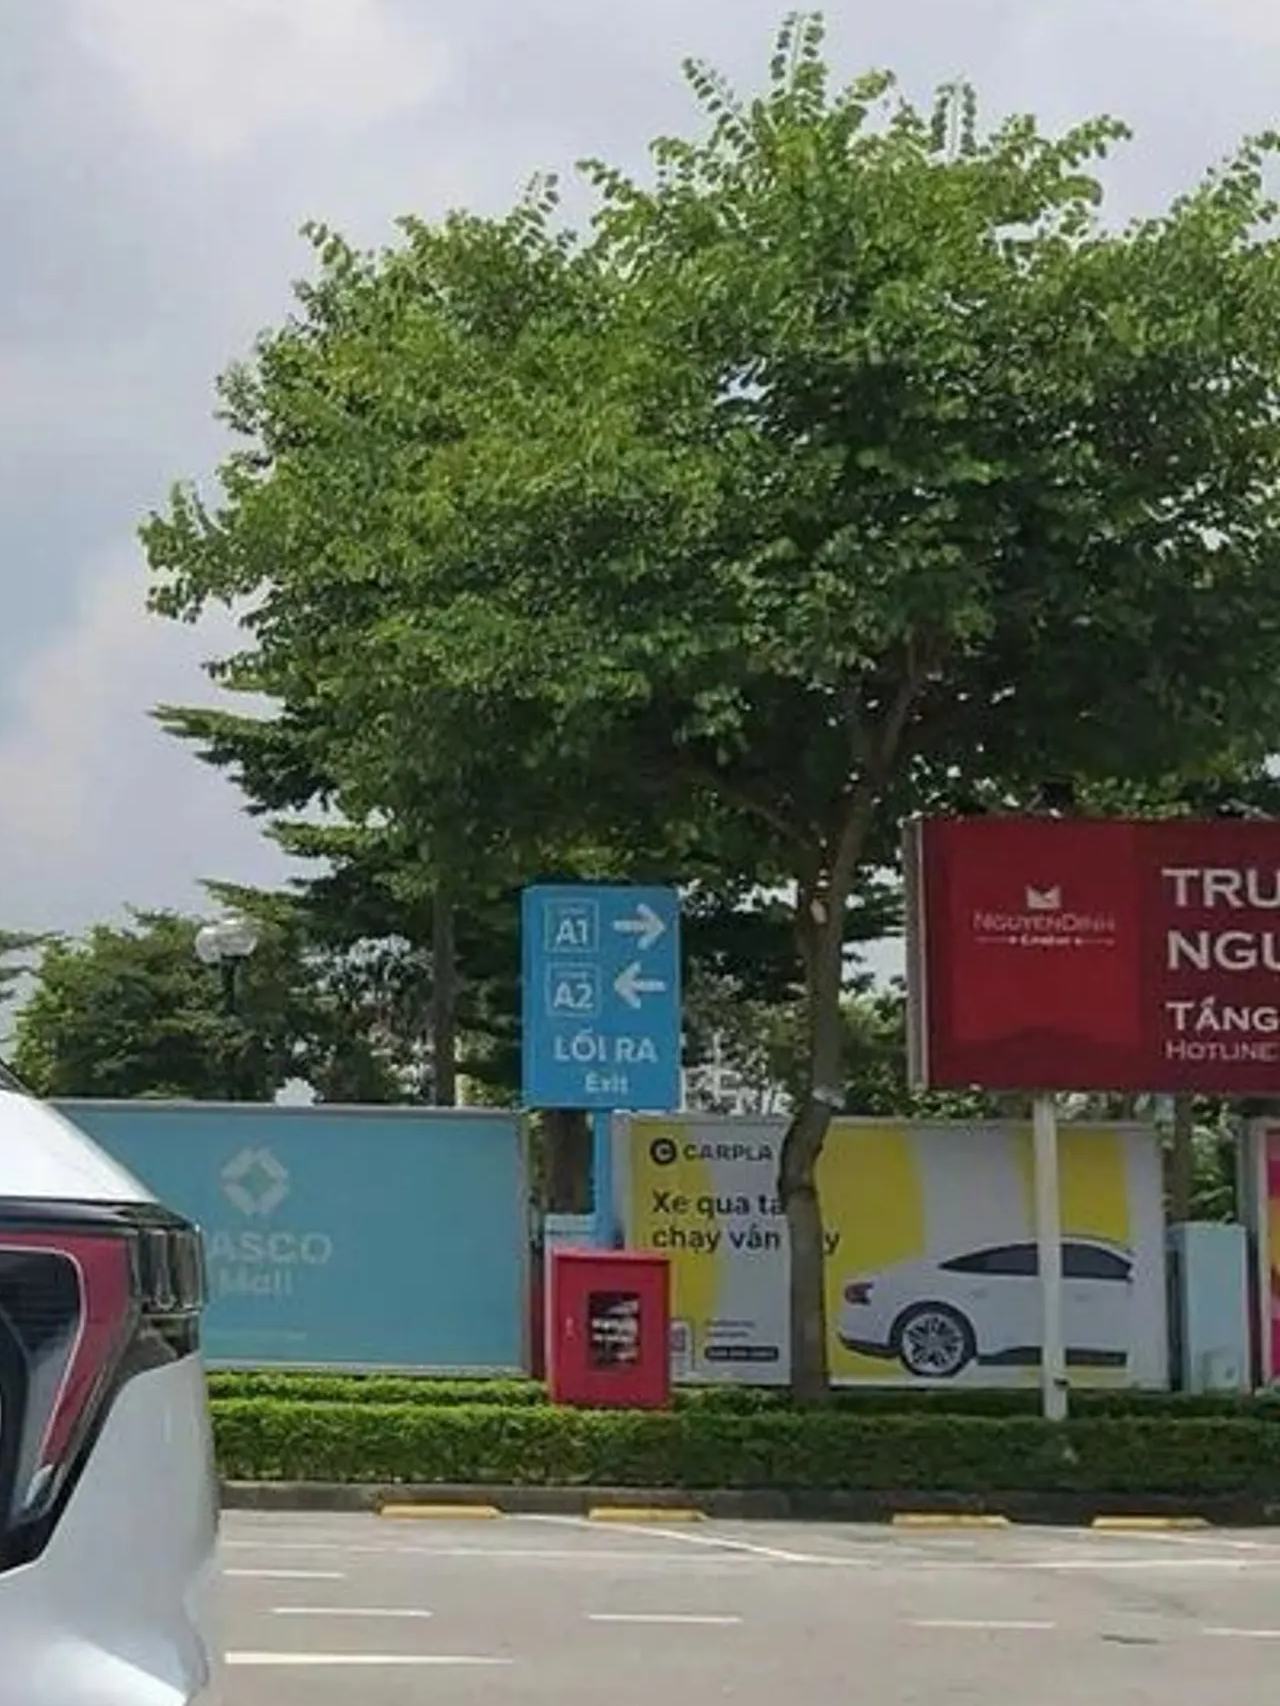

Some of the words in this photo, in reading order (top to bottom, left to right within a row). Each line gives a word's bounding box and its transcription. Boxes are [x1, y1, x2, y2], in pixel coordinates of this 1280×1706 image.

[1161, 867, 1280, 908] TRU
[556, 918, 588, 944] A1
[553, 981, 593, 1008] A2
[614, 1037, 658, 1063] RA
[585, 1071, 629, 1094] Exit
[683, 1143, 773, 1161] CARPLA
[652, 1189, 689, 1214] Xe
[696, 1194, 750, 1219] qua
[758, 1193, 787, 1215] ta
[204, 1231, 333, 1264] ASCO
[652, 1225, 721, 1253] chạy
